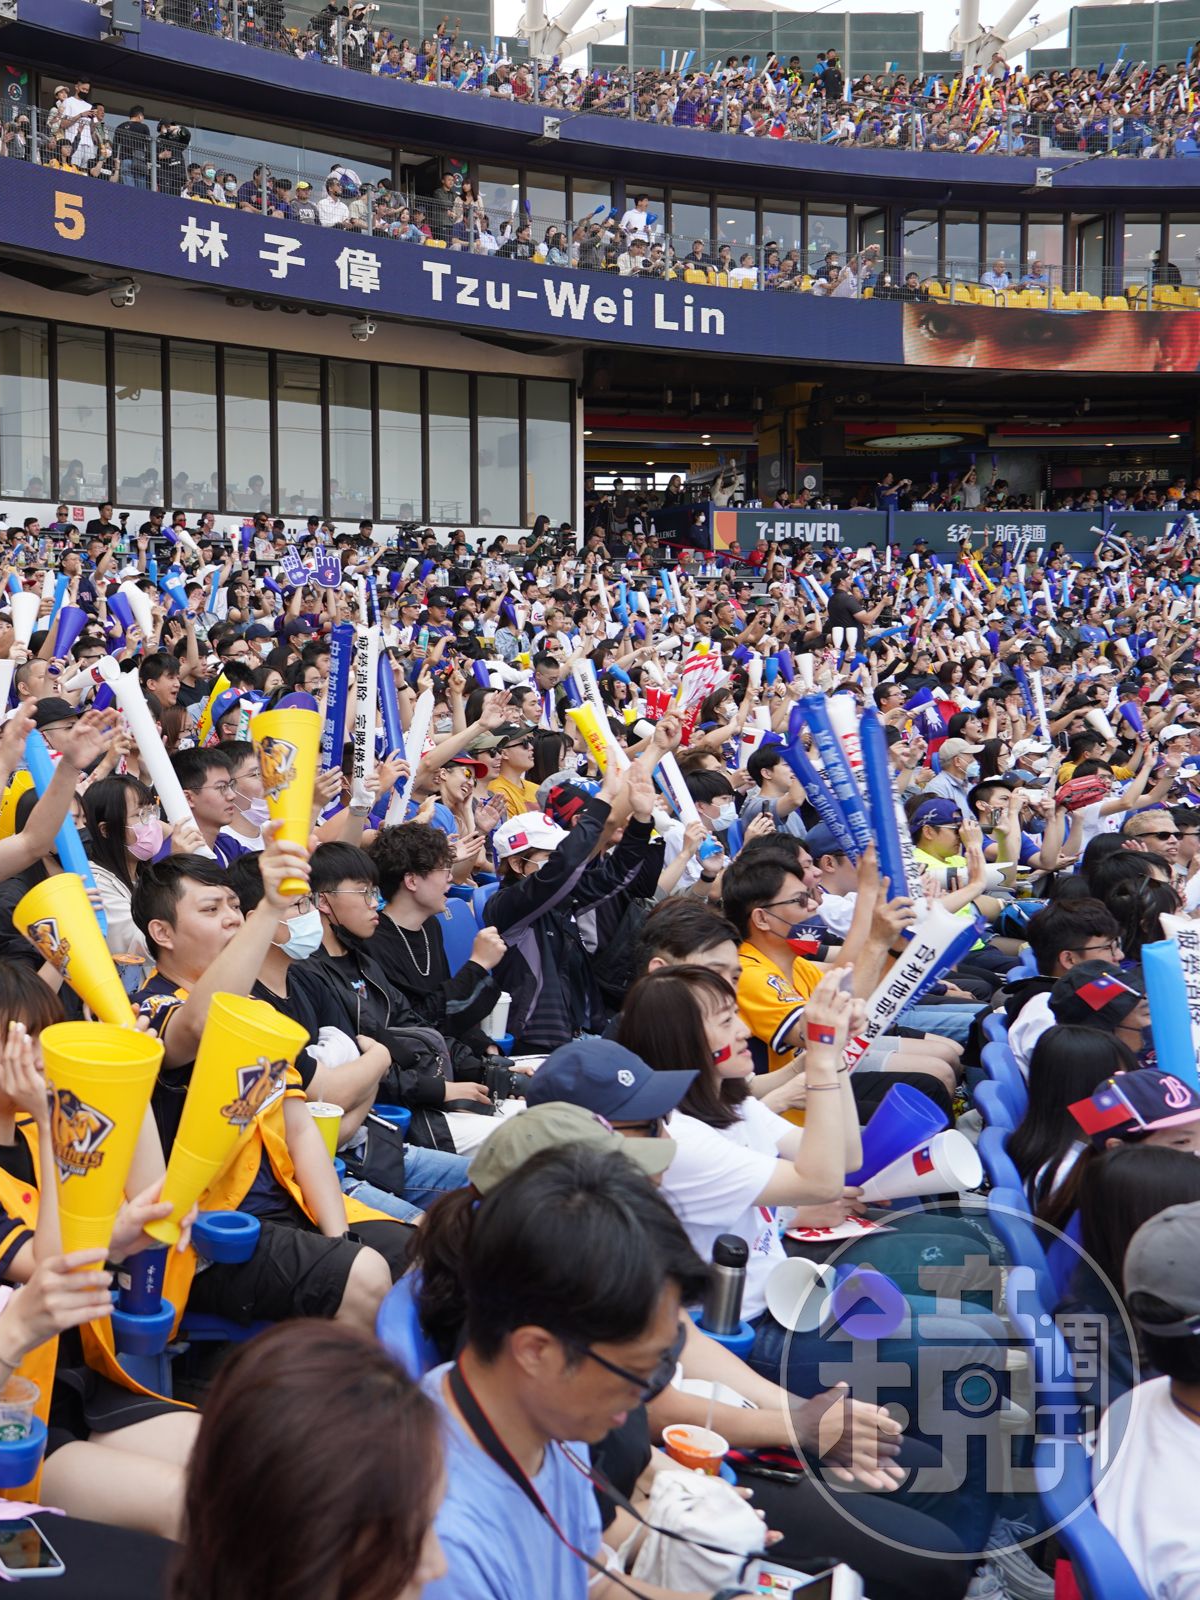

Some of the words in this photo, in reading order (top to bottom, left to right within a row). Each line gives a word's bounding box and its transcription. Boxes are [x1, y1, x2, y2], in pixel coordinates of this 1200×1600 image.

[53, 191, 86, 241] 5
[180, 216, 382, 294] 林子偉
[422, 260, 634, 326] Tzu-Wei
[654, 295, 726, 336] Lin
